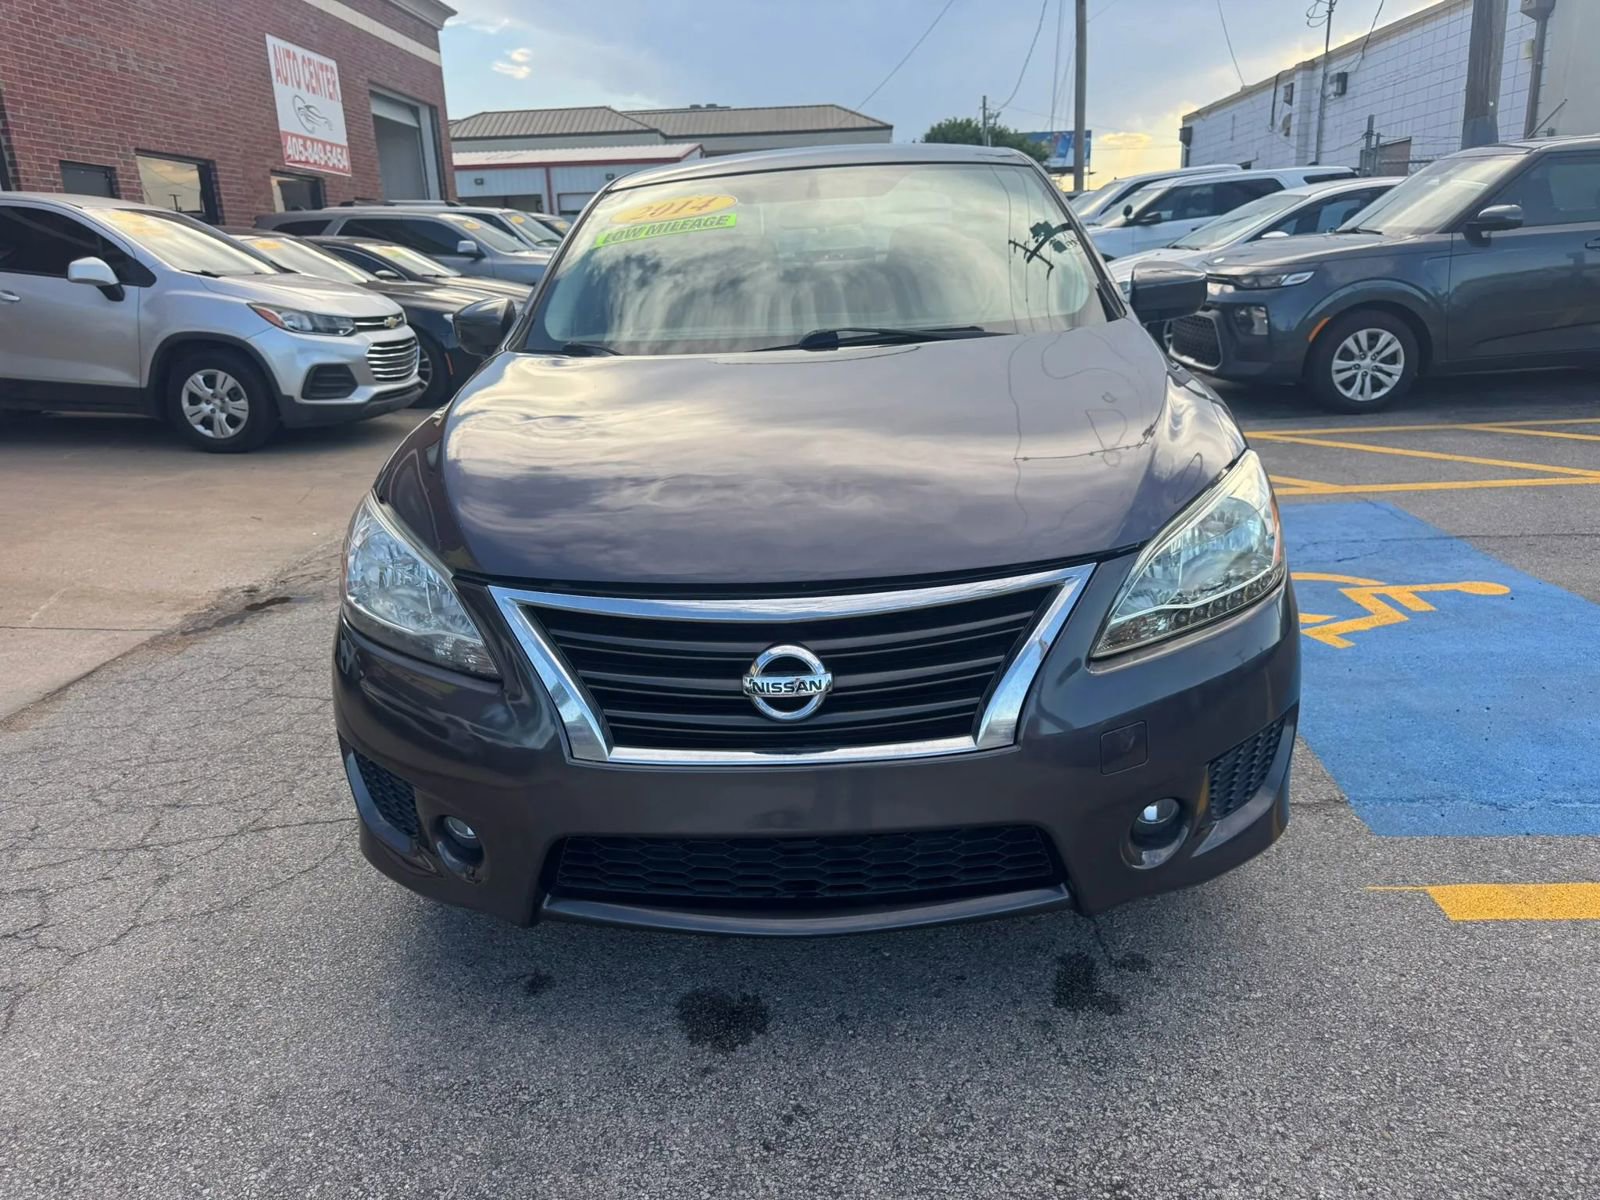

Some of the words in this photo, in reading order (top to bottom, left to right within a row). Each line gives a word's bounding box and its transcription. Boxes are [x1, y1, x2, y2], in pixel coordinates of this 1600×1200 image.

[273, 44, 302, 89] AUTO
[302, 55, 341, 102] CENTER
[630, 197, 719, 220] 2014
[603, 227, 643, 244] LOW
[644, 215, 732, 236] MILEAGE
[752, 679, 822, 693] NISSAN
